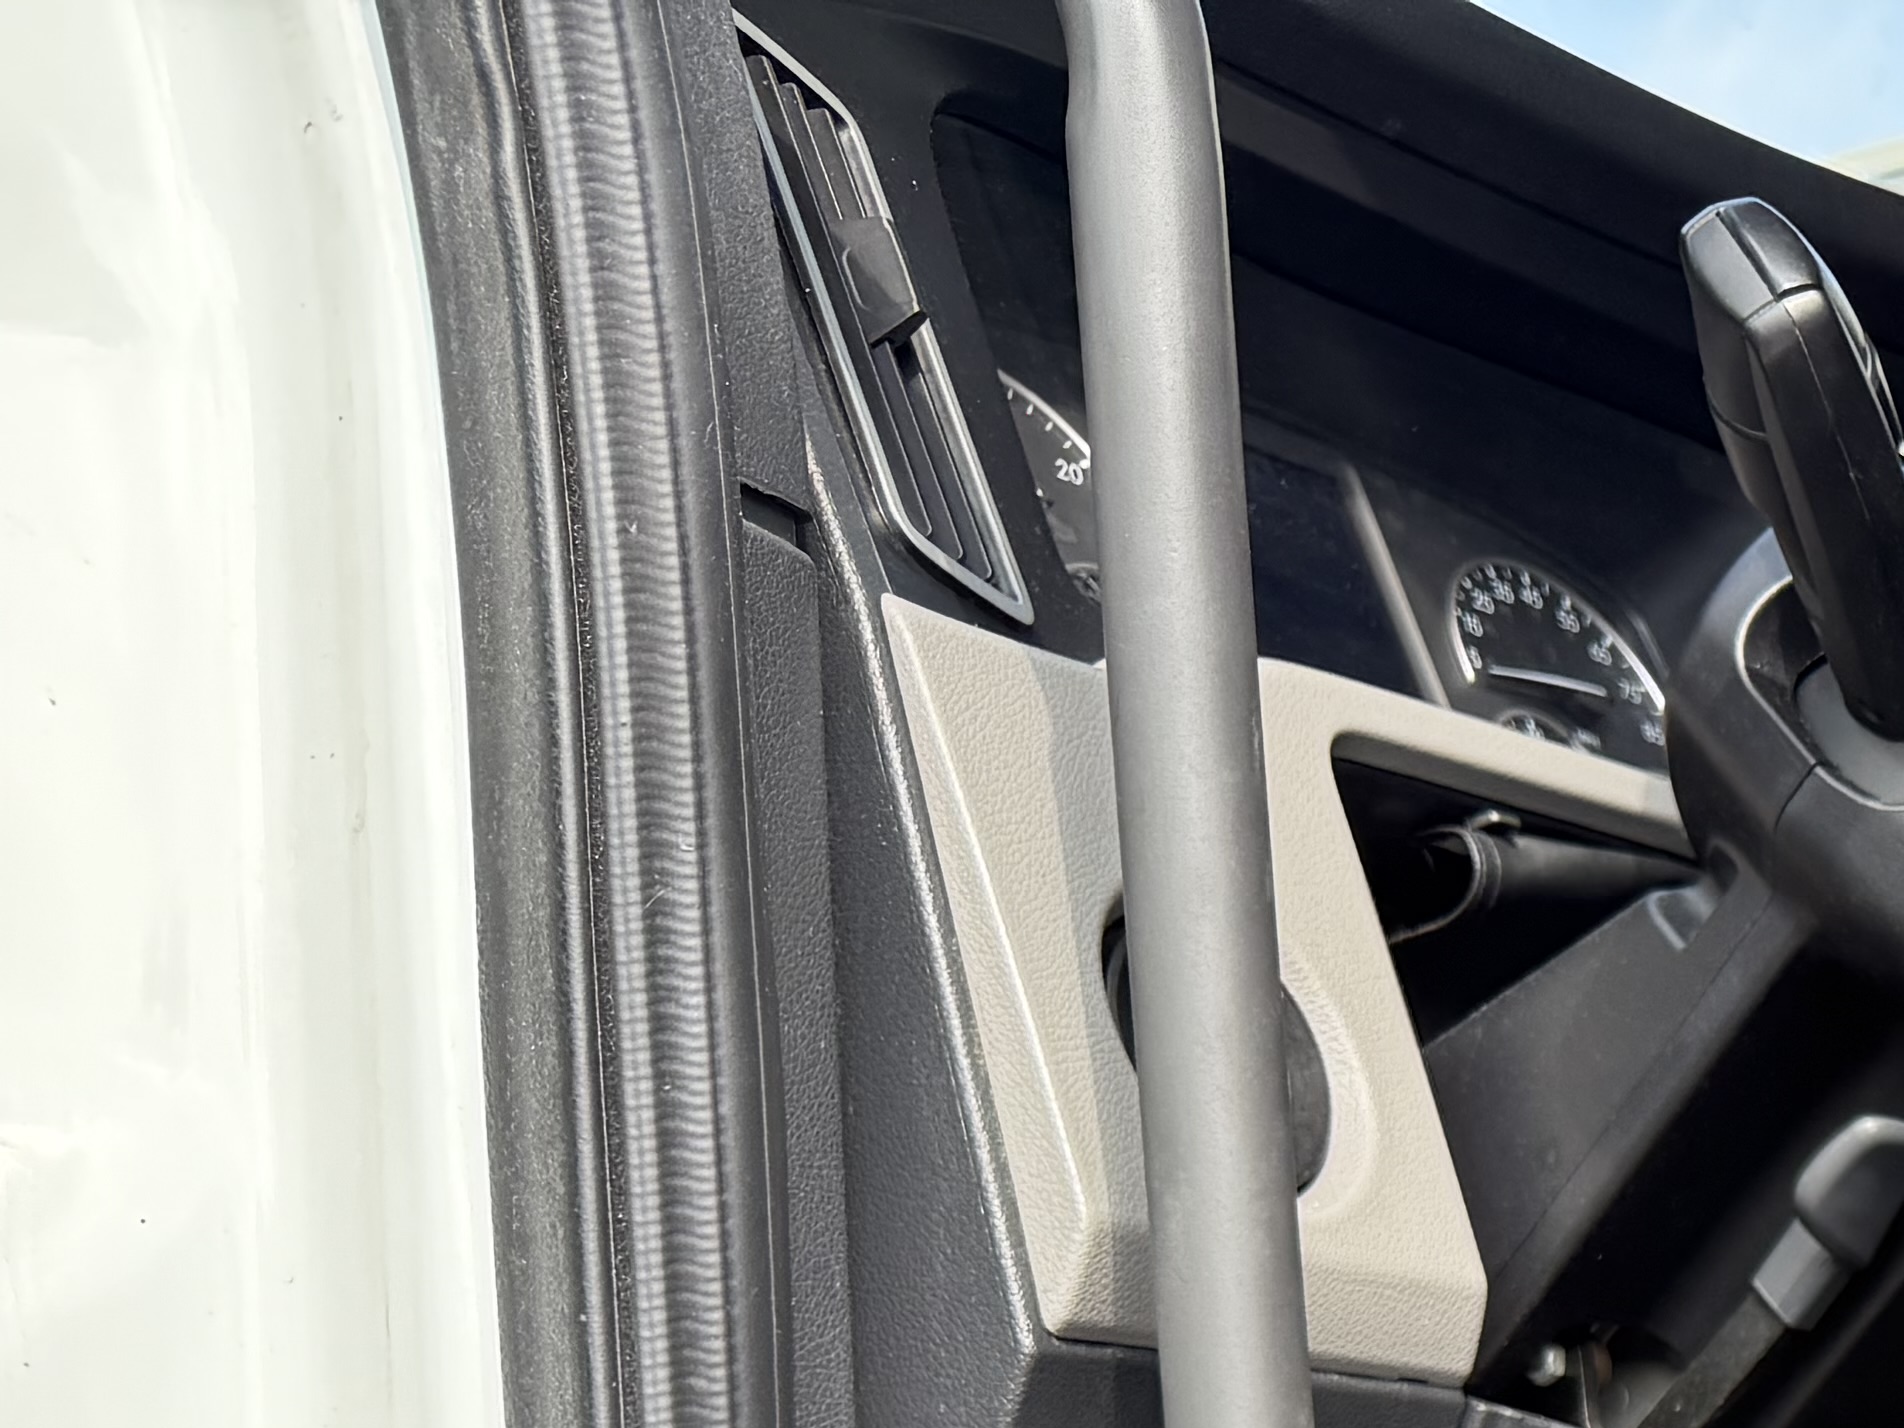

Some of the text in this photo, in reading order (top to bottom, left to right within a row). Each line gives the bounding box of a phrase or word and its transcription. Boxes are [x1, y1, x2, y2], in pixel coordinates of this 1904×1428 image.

[1055, 457, 1084, 486] 20
[1555, 608, 1581, 634] 55
[1587, 640, 1613, 666] 65
[1617, 677, 1644, 705] 75
